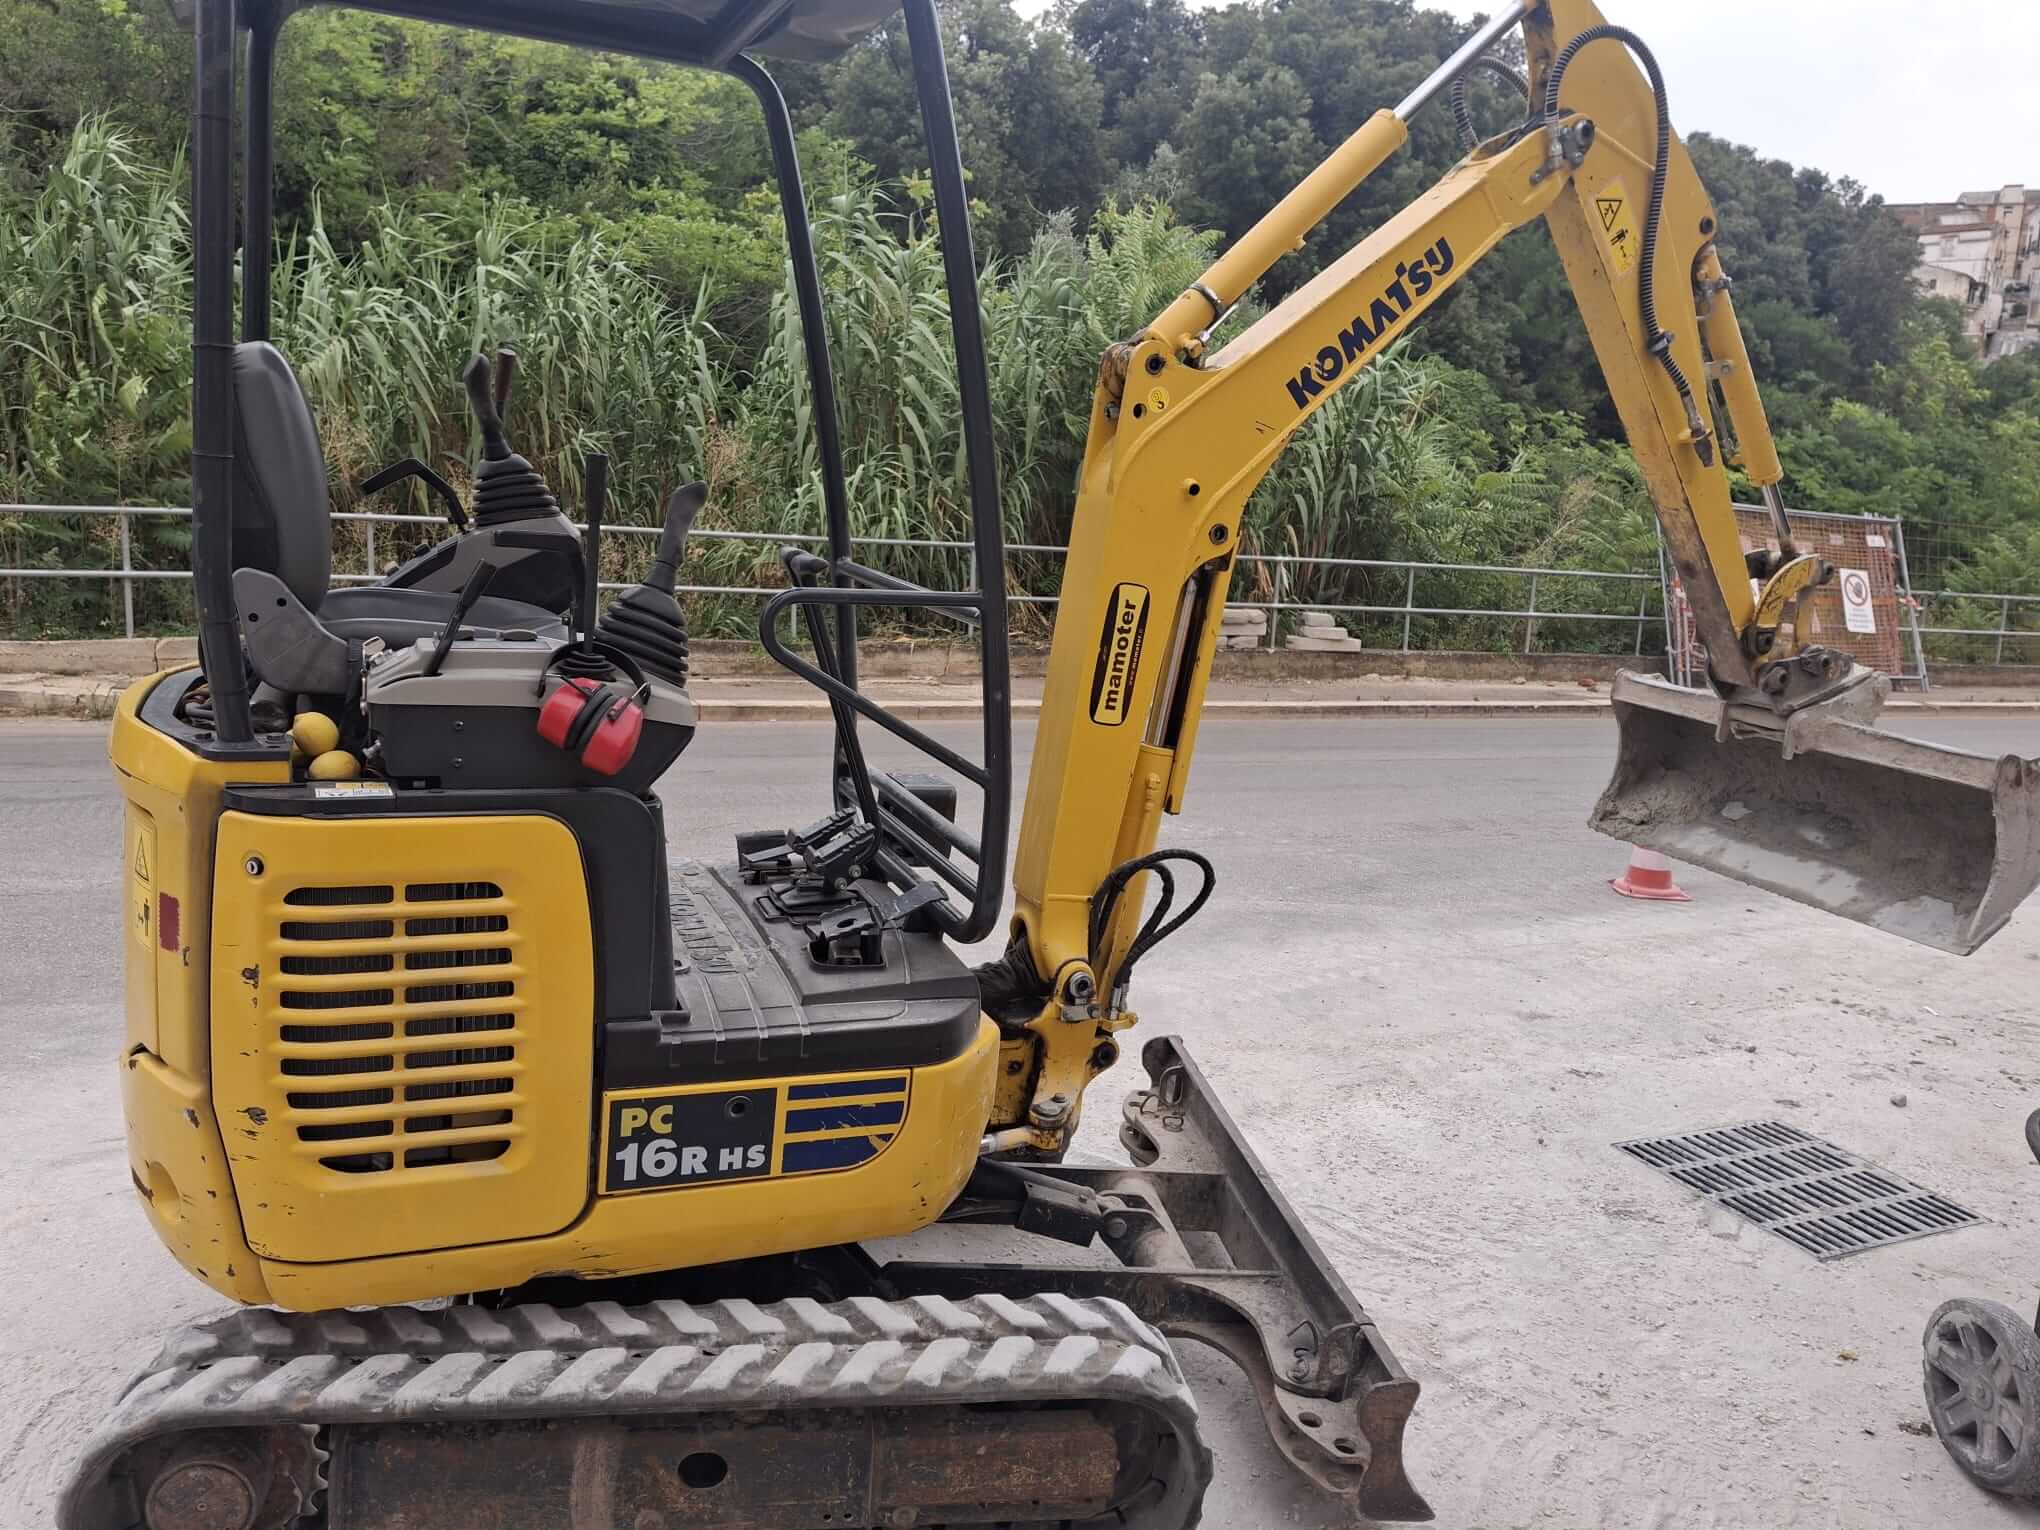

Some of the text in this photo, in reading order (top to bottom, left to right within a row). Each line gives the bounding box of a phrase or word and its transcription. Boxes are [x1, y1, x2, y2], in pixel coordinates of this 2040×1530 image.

[1286, 236, 1455, 410] KOMATSU
[1104, 599, 1137, 711] mamoter
[620, 1104, 674, 1137] PC
[615, 1138, 766, 1182] 16R HS
